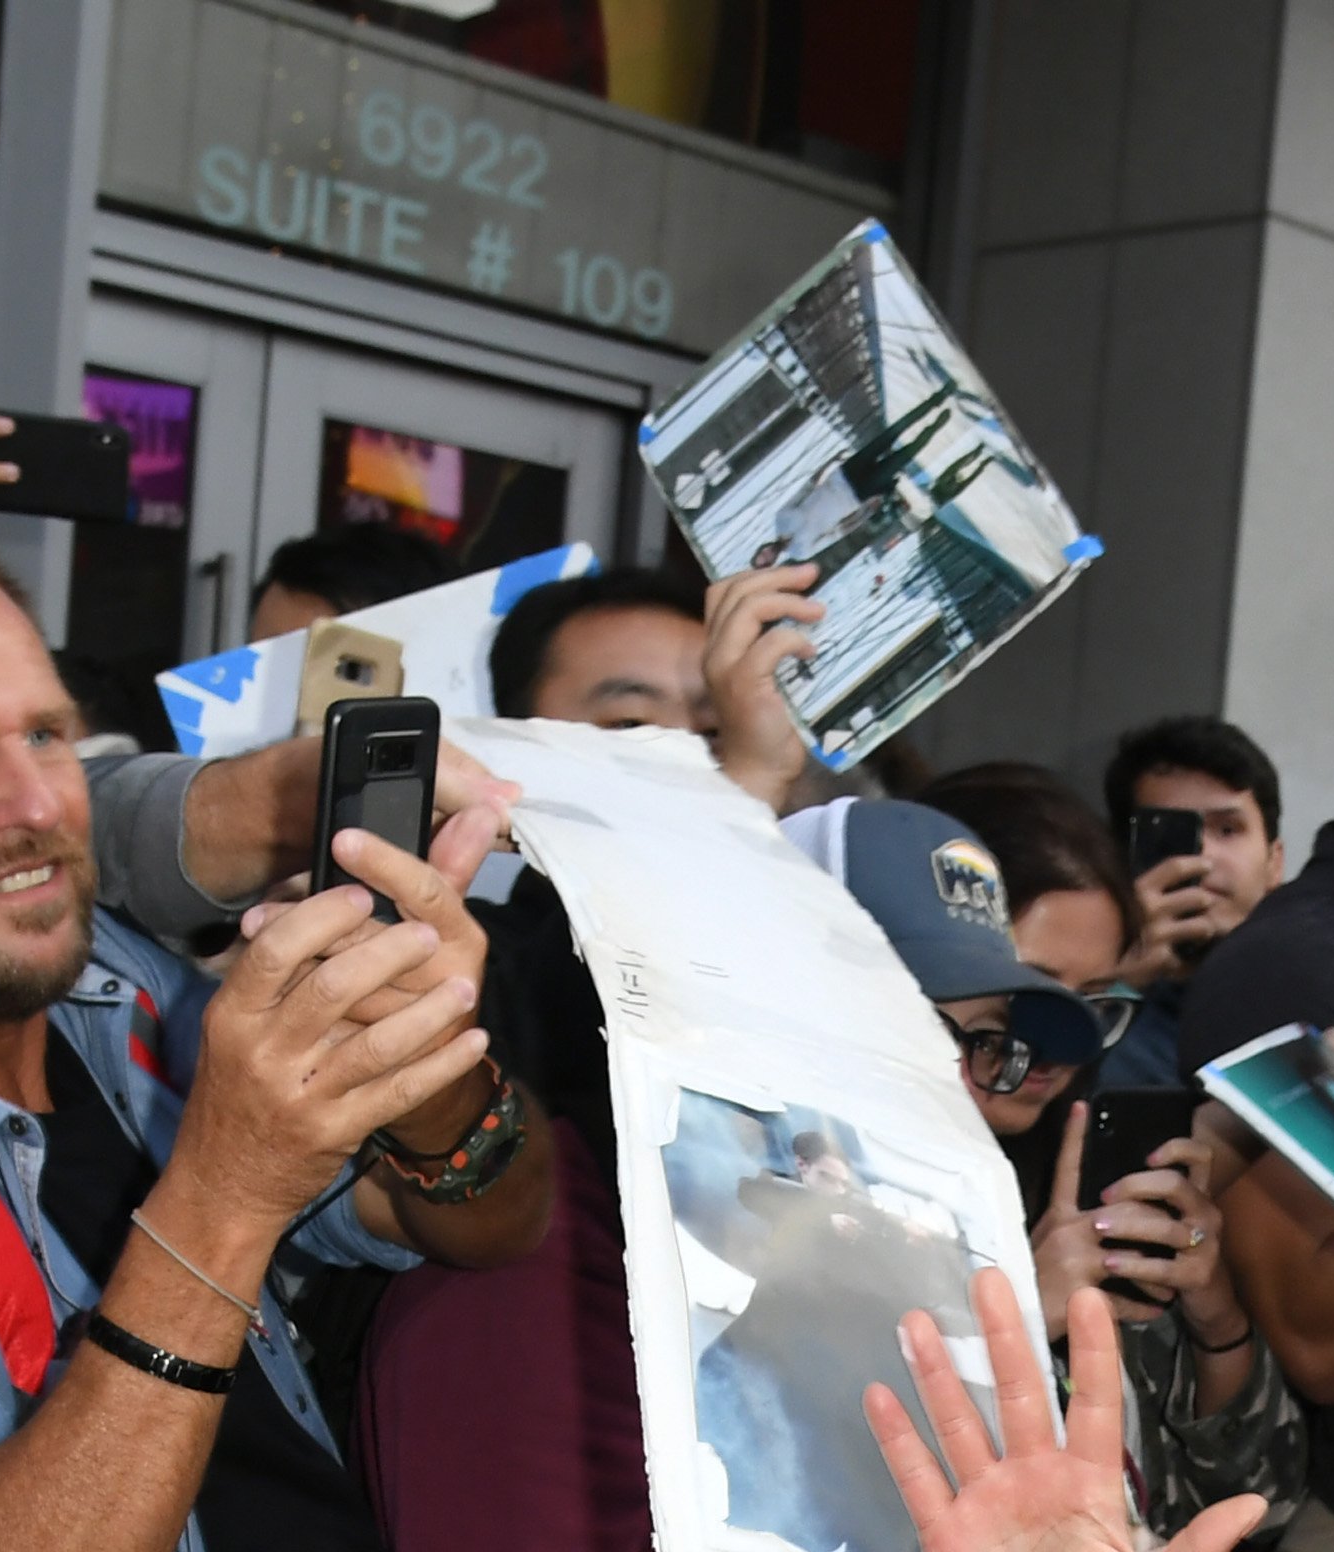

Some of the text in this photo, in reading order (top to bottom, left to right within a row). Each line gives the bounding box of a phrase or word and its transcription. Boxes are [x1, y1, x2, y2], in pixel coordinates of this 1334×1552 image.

[359, 90, 549, 211] 6922
[196, 144, 676, 339] SUITE # 109
